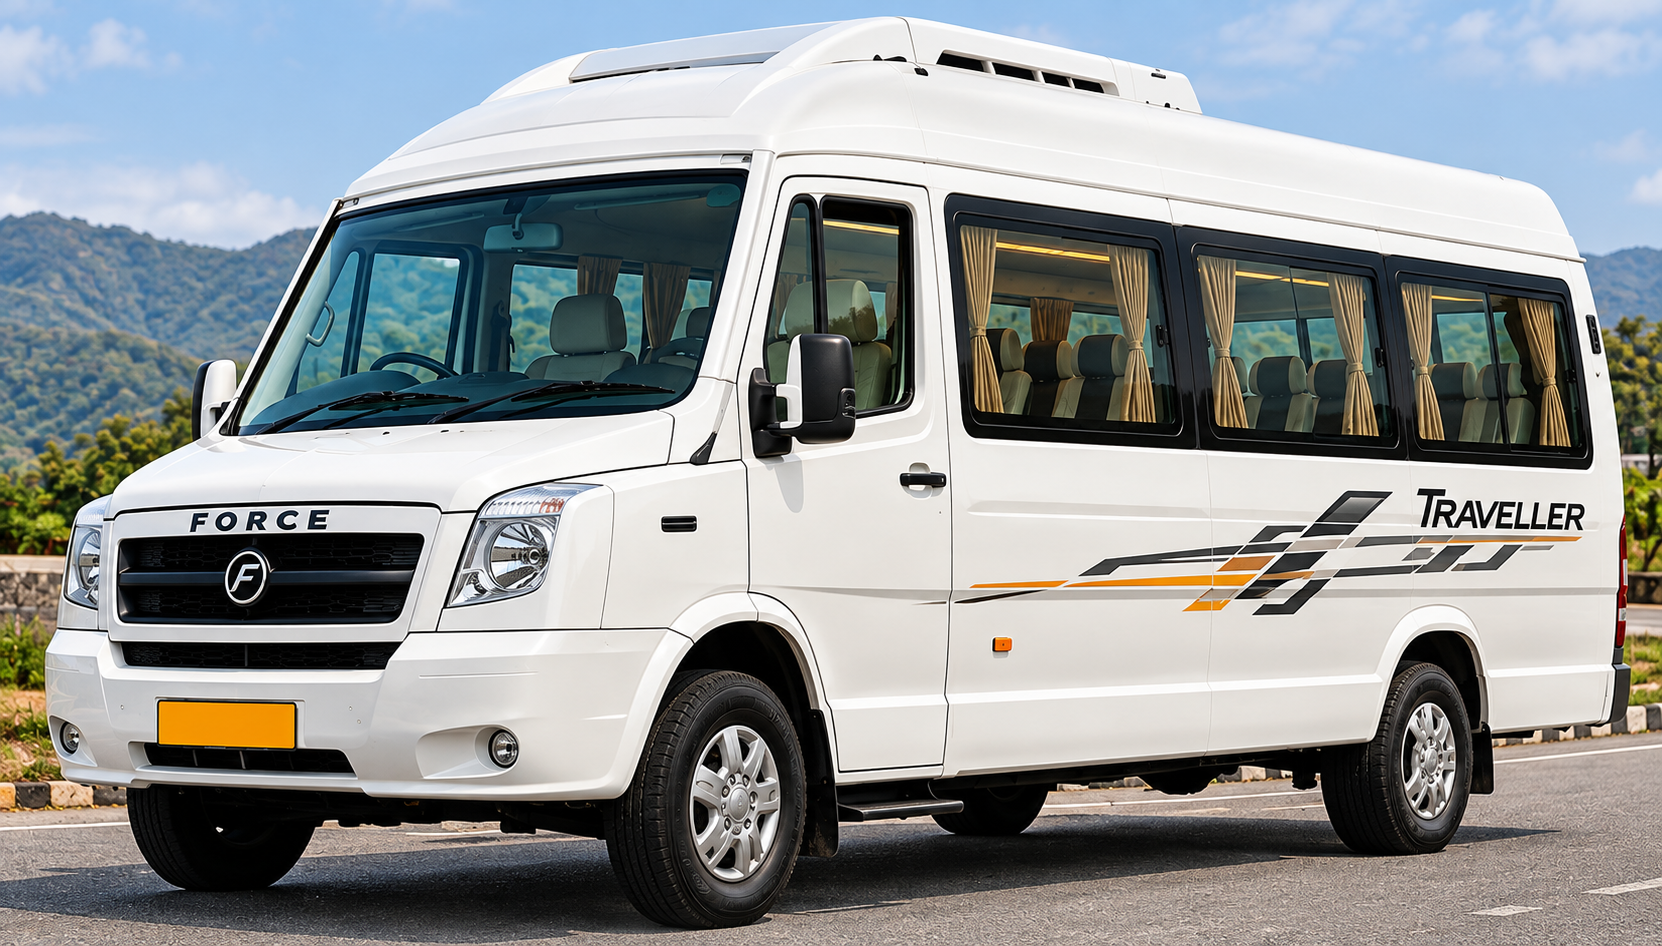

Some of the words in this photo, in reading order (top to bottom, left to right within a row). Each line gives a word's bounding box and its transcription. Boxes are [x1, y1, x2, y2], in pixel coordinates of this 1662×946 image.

[189, 509, 330, 533] FORCE
[1417, 488, 1585, 531] TRAVELLER
[229, 563, 261, 592] F
